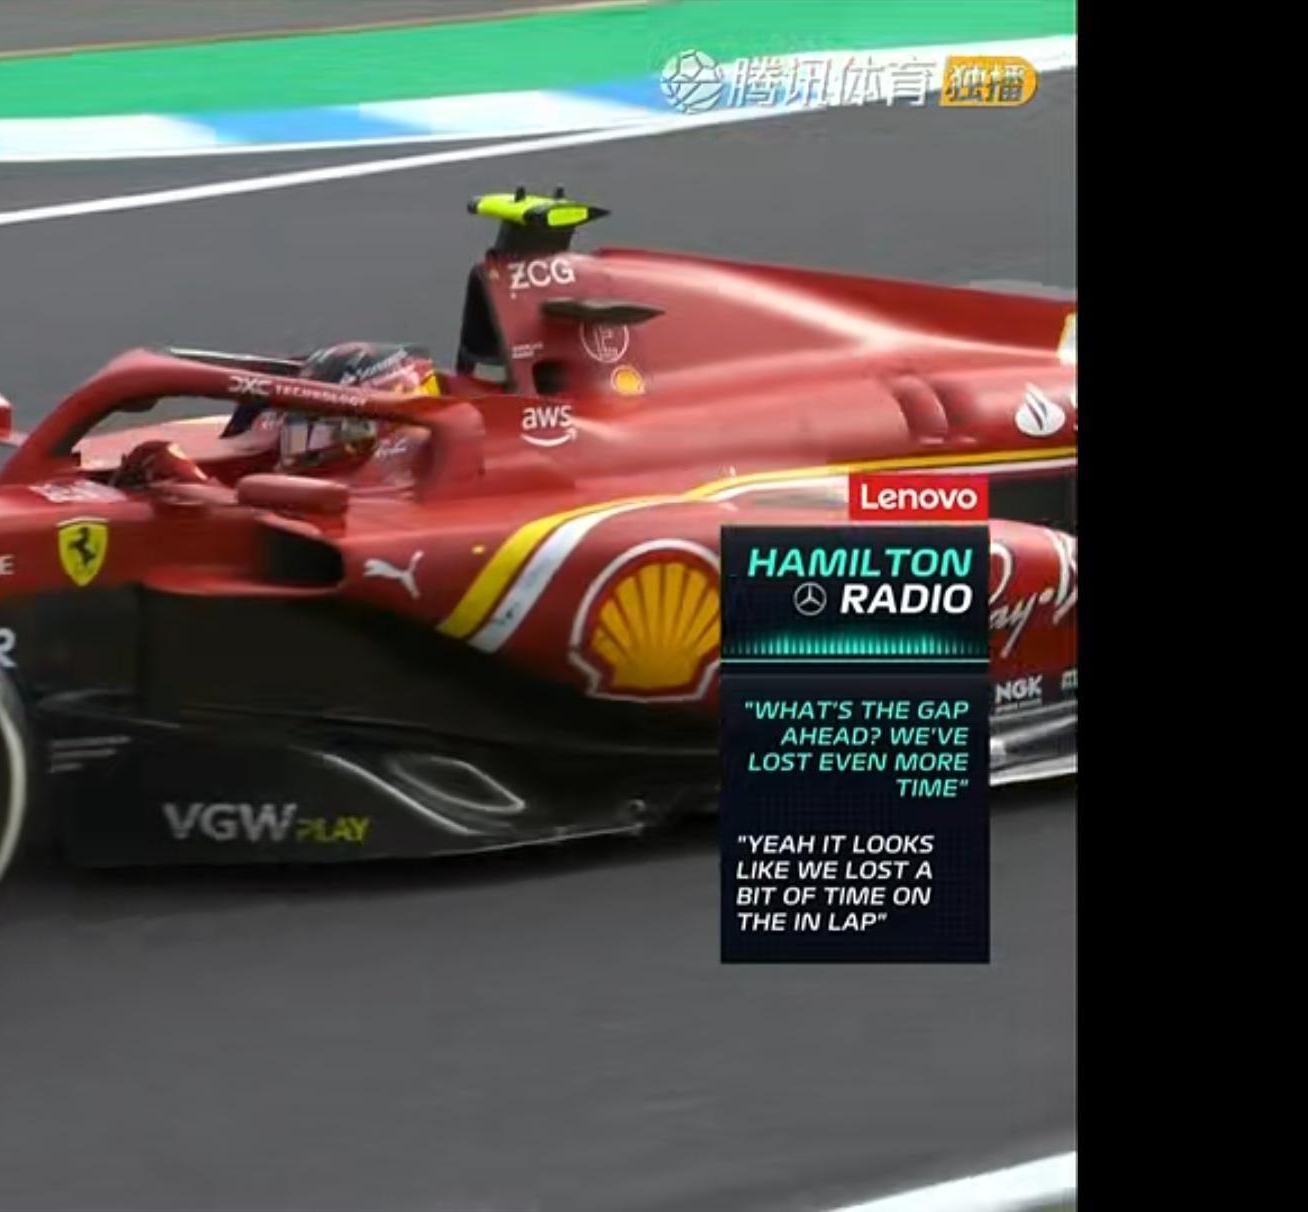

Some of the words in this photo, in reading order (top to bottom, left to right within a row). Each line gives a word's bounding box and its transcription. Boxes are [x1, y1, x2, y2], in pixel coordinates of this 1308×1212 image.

[508, 258, 576, 290] ZCG
[521, 404, 574, 431] aws
[995, 675, 1043, 702] NGK
[162, 802, 298, 842] VGW
[296, 816, 371, 843] PLAY
